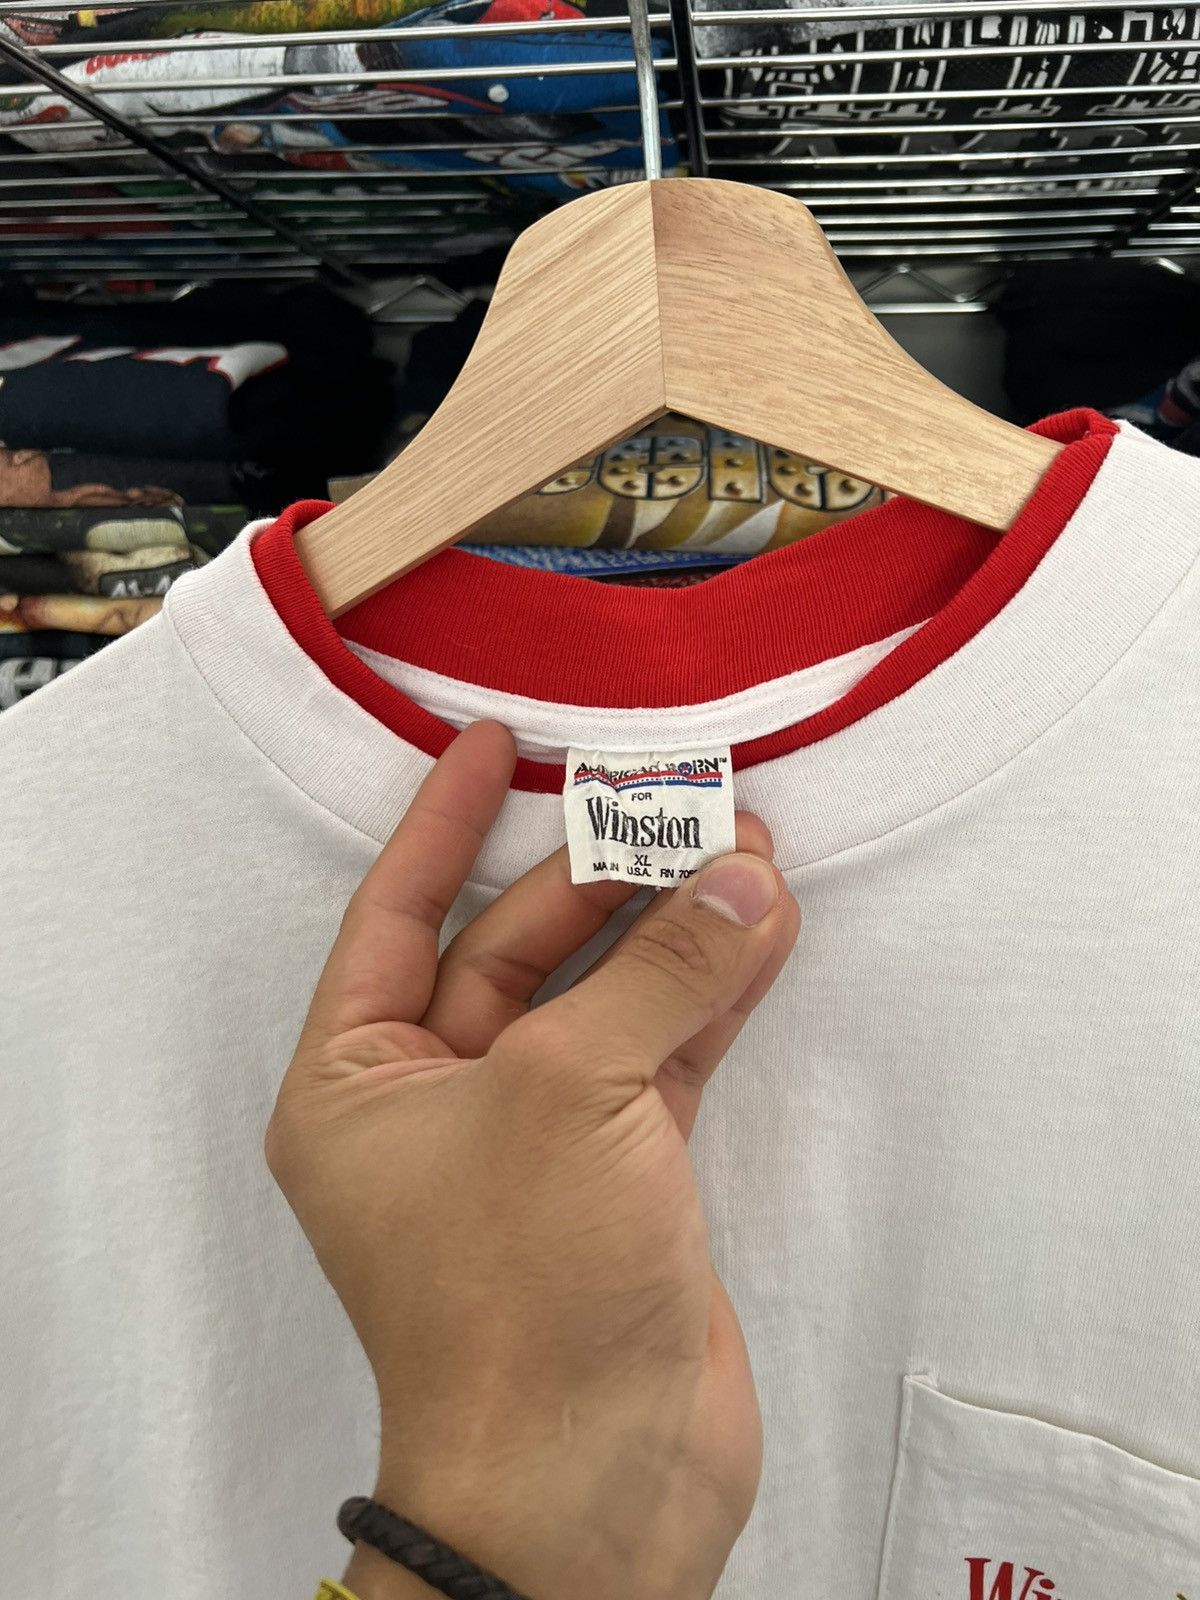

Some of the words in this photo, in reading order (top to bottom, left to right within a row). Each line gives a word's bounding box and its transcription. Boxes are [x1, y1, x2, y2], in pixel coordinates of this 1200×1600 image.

[631, 792, 653, 801] FOR
[586, 795, 703, 849] Winston
[634, 854, 652, 867] XL
[660, 868, 674, 878] RN
